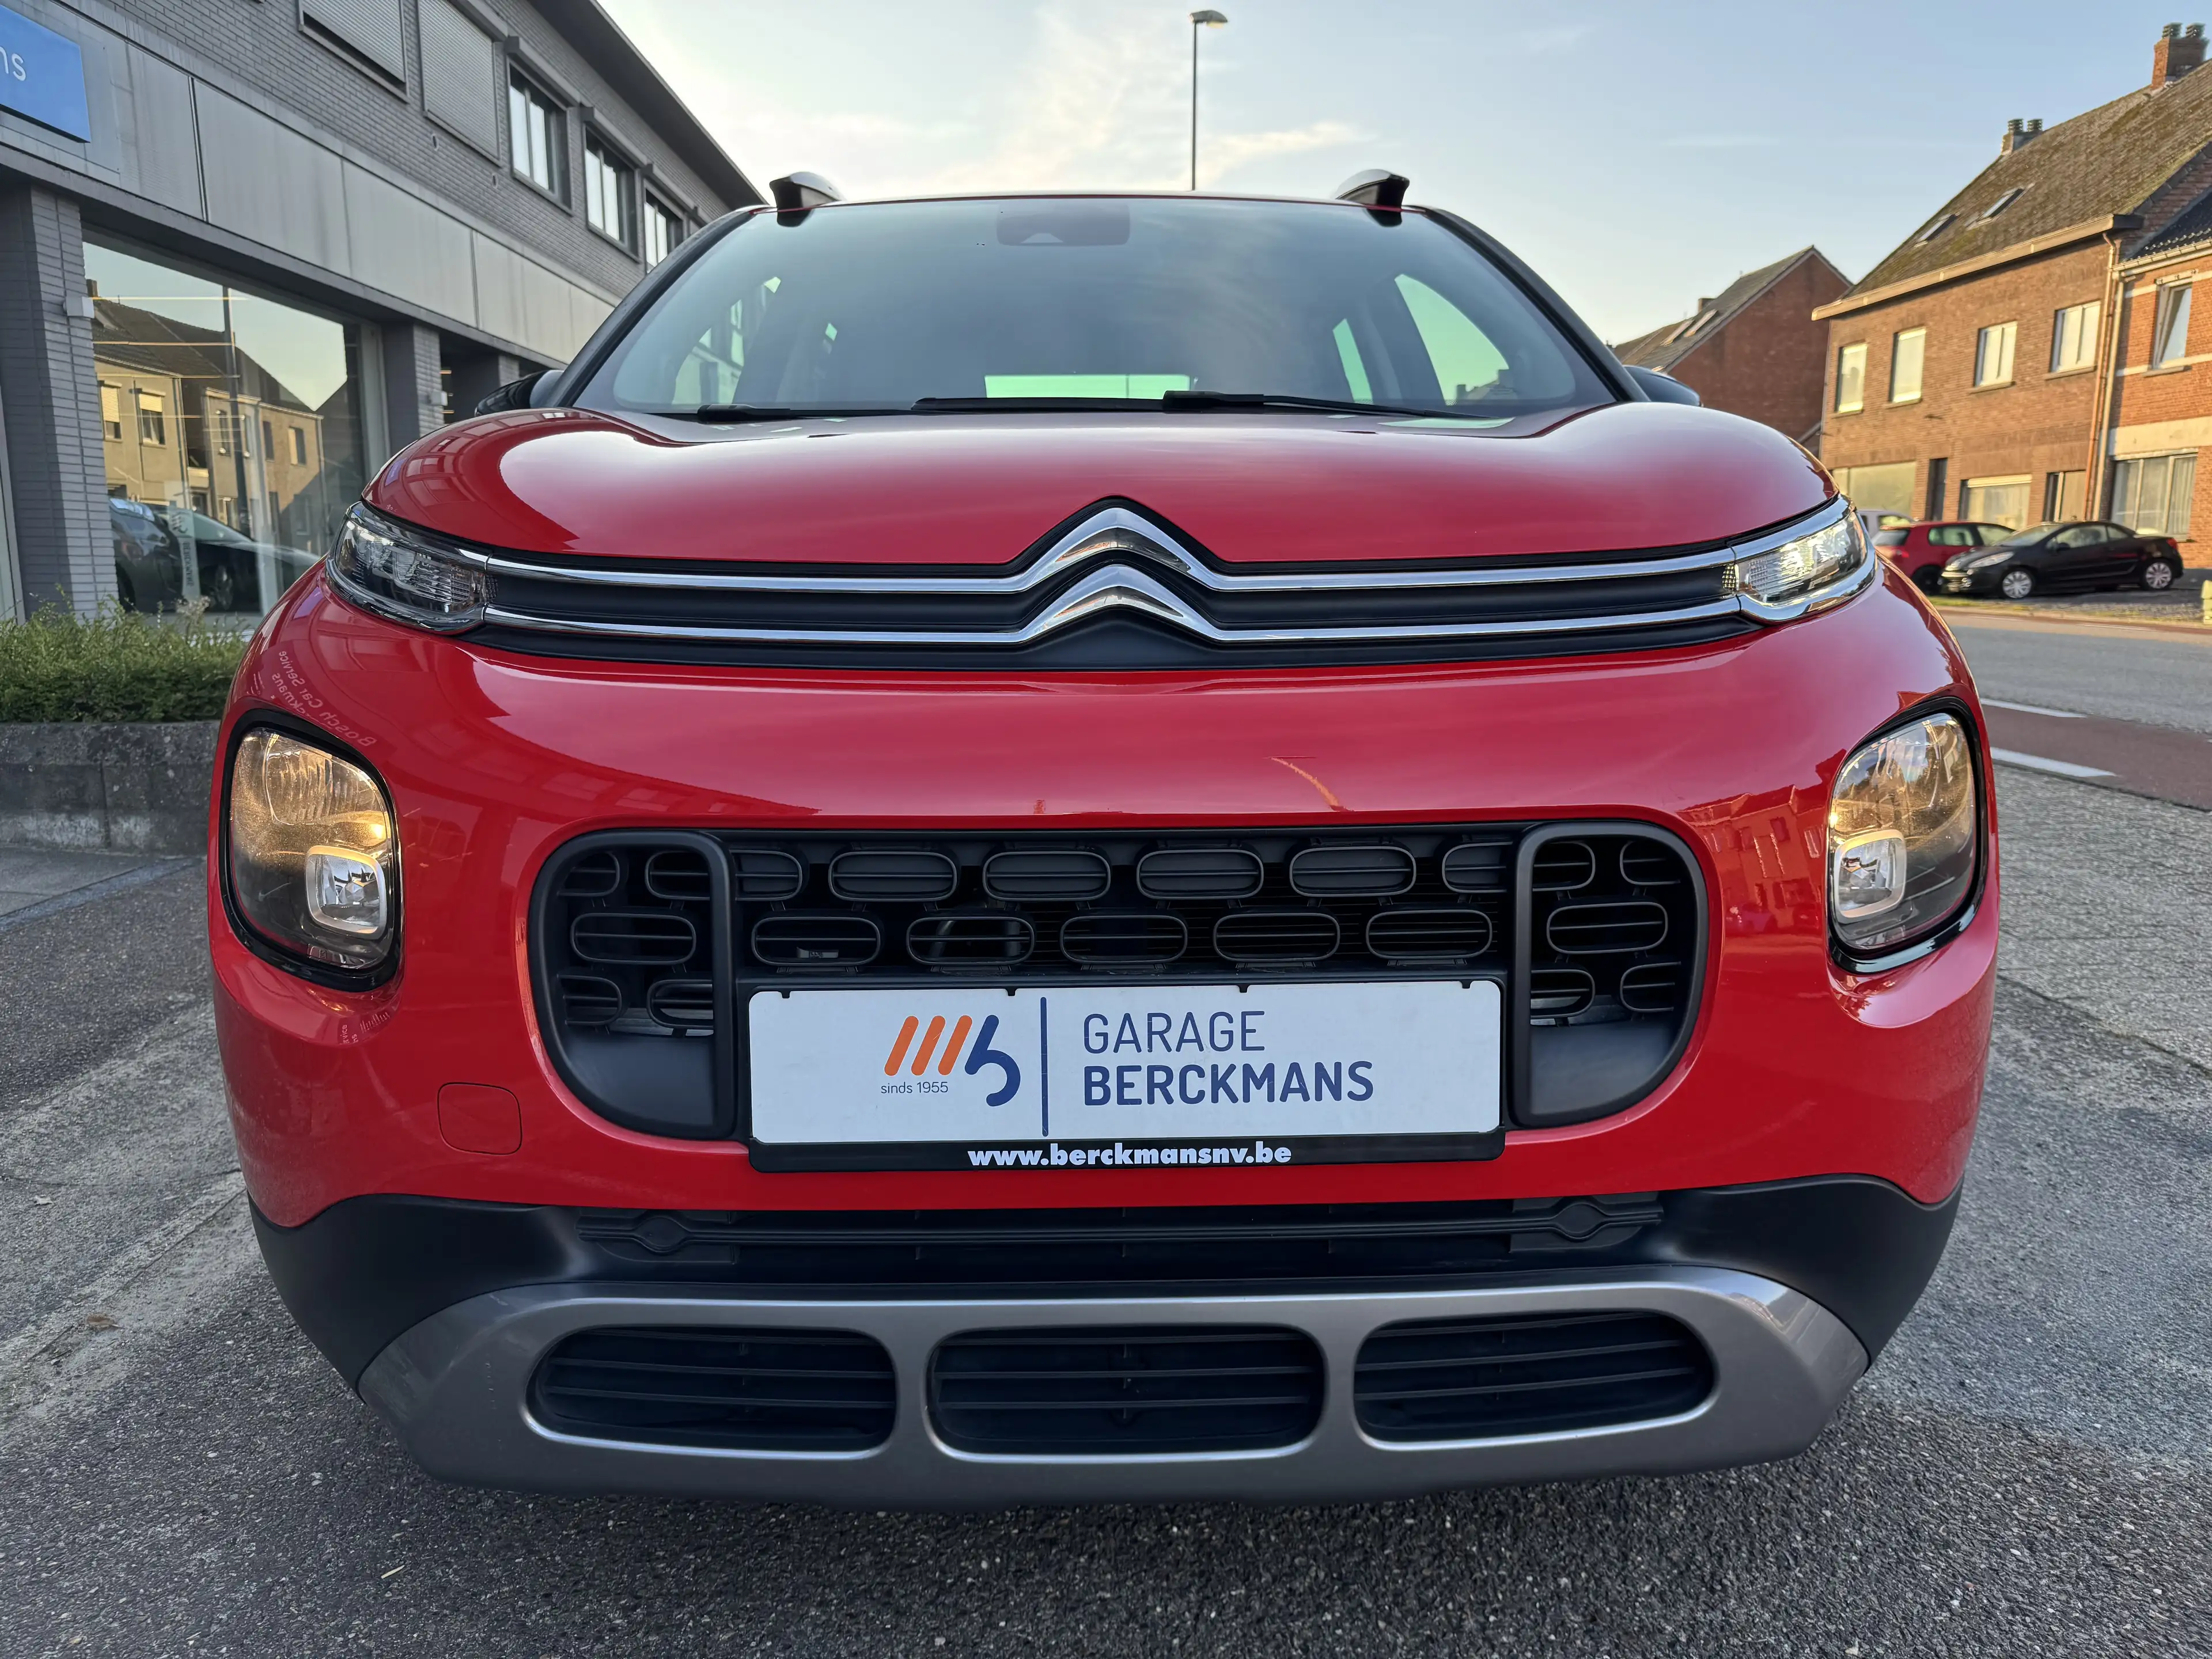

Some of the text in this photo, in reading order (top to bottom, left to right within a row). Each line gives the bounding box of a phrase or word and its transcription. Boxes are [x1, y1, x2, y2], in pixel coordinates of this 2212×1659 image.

[1084, 1010, 1266, 1054] GARAGE
[881, 1081, 948, 1094] sinds 1955
[1084, 1060, 1374, 1106] BERCKMANS
[967, 1141, 1291, 1166] www.berckmansnv.be
